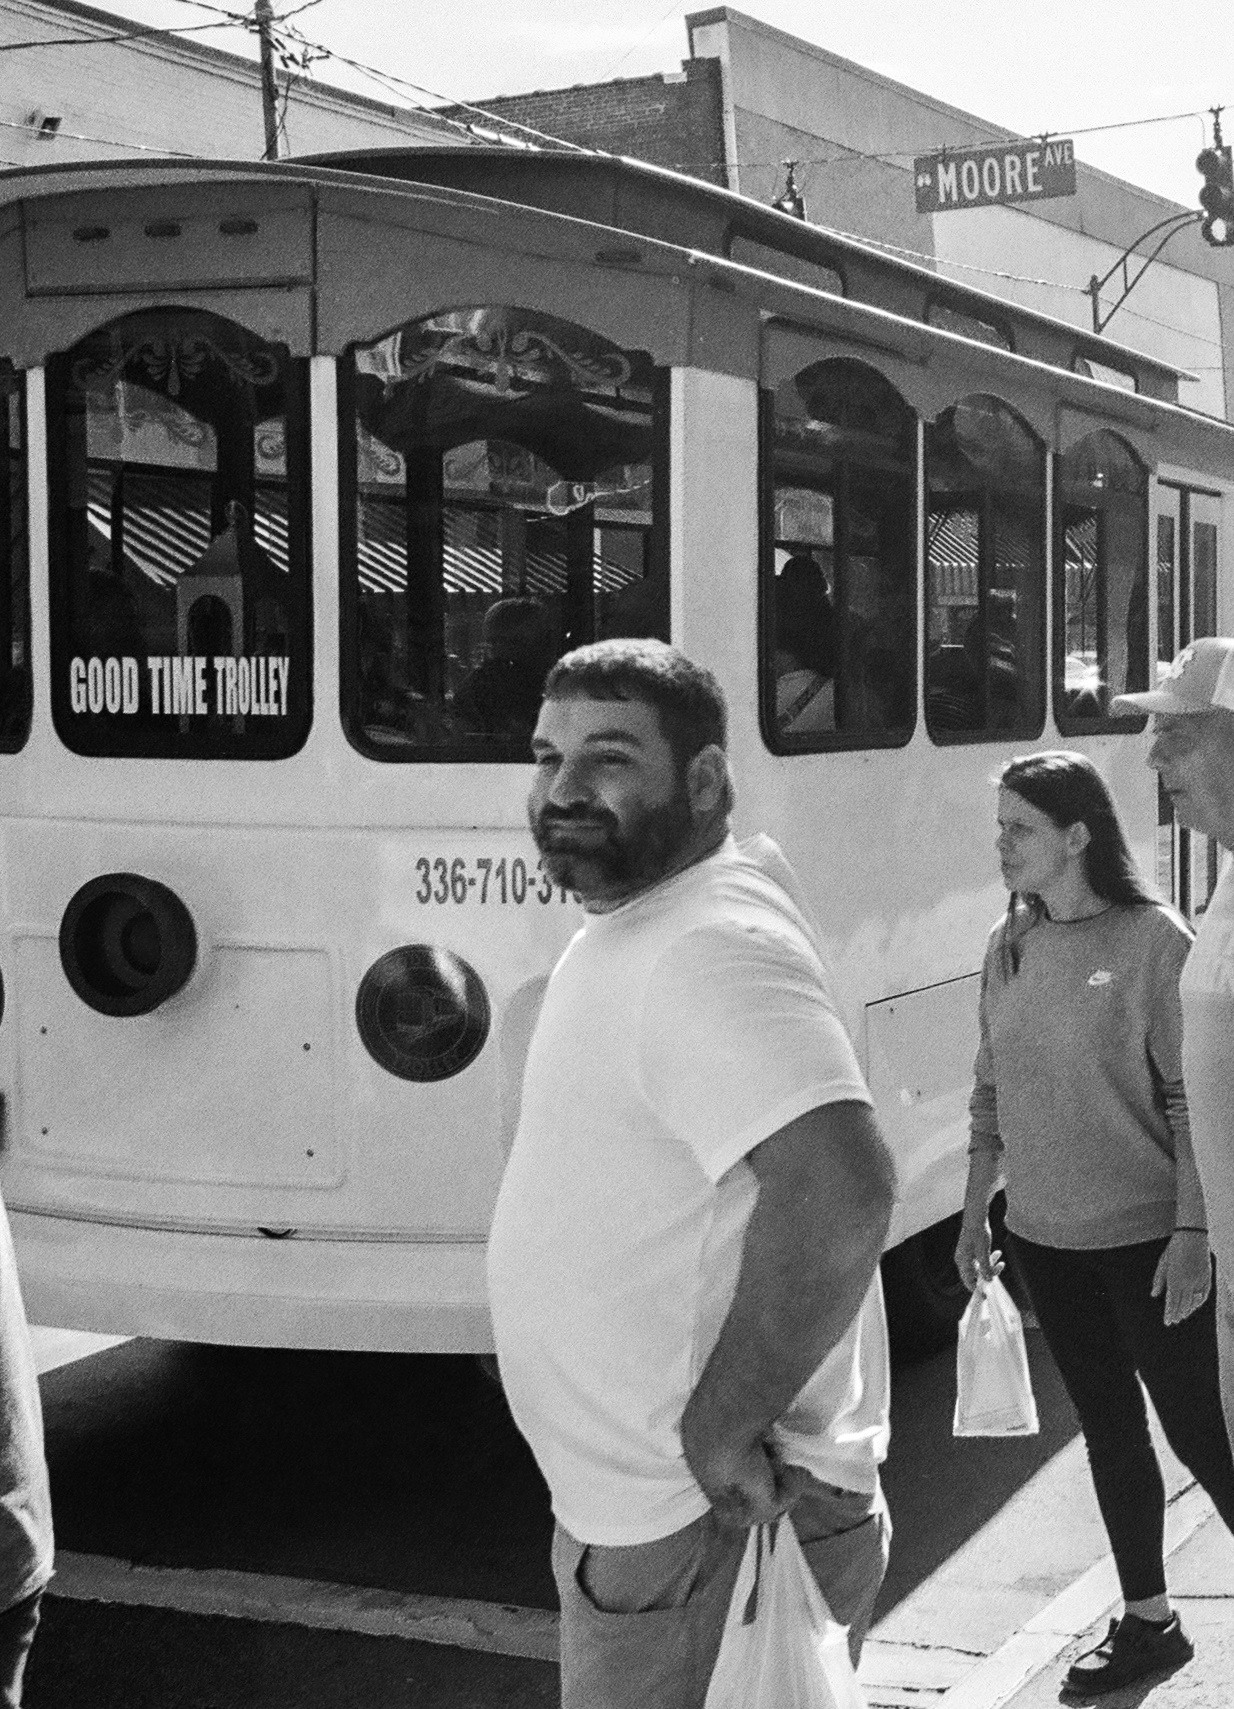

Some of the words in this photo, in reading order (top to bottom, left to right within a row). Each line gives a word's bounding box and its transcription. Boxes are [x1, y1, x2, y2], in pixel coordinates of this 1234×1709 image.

[937, 151, 1044, 203] MOORE
[1044, 143, 1073, 167] AVE
[70, 656, 139, 714] GOOD
[147, 656, 207, 715] TIME
[214, 656, 289, 715] TROLLEY
